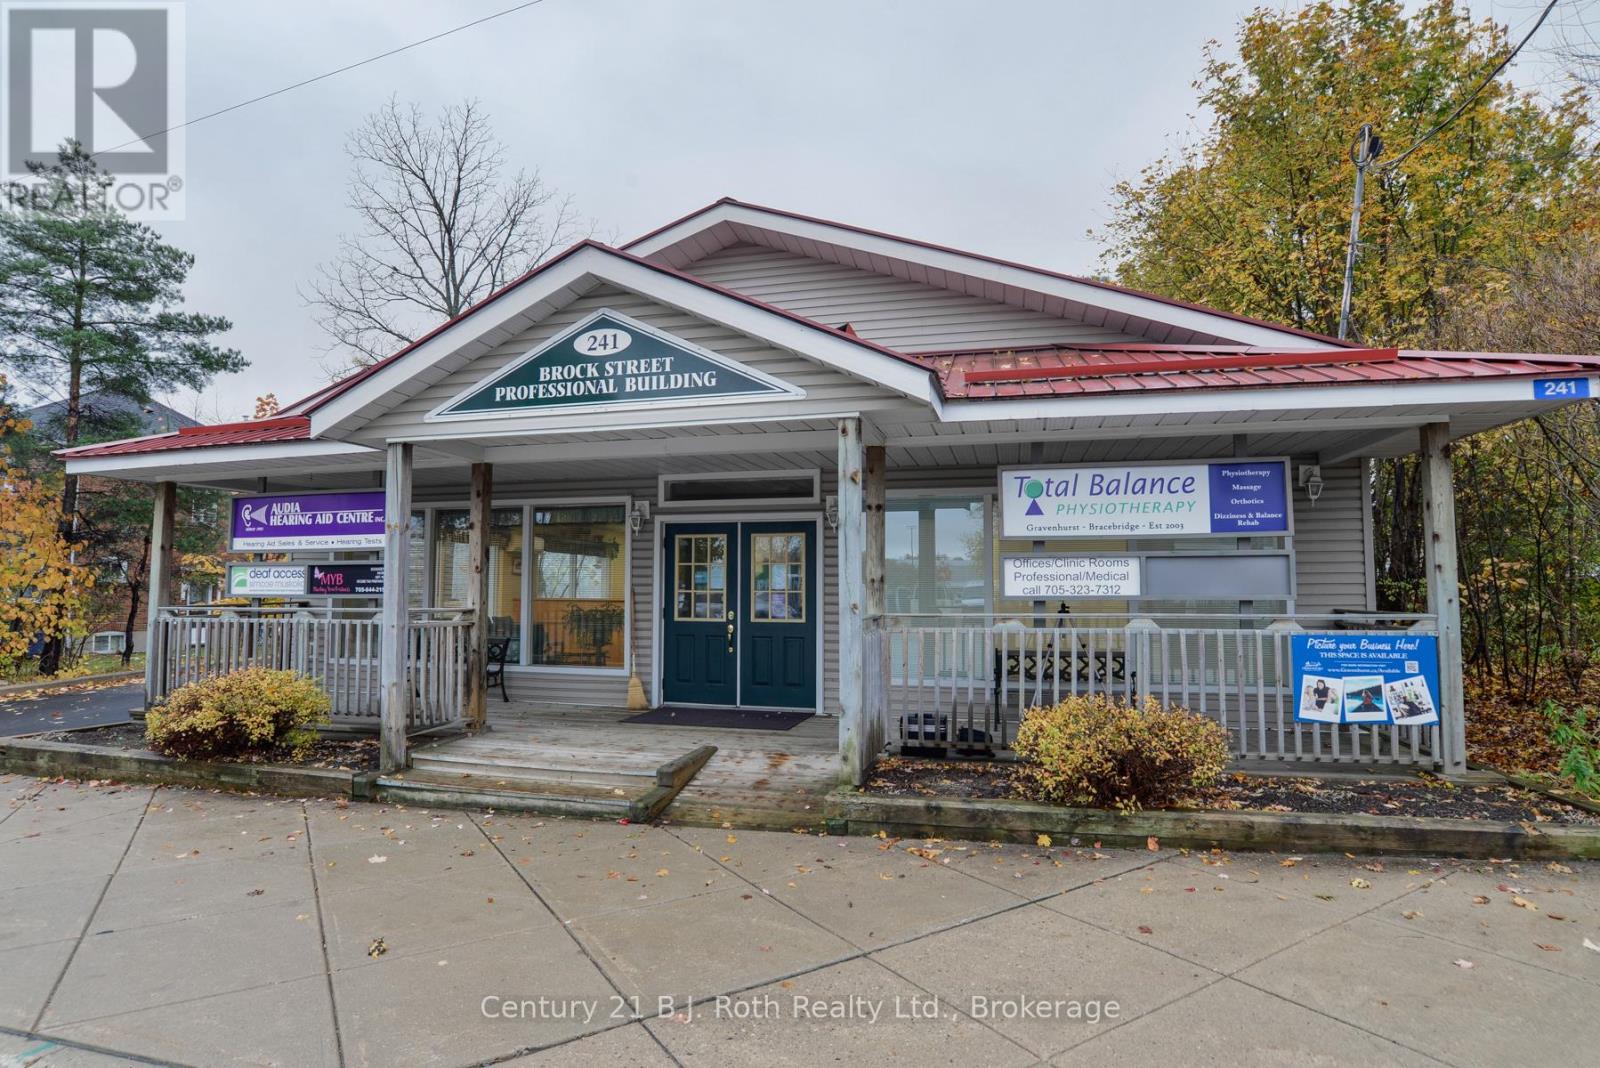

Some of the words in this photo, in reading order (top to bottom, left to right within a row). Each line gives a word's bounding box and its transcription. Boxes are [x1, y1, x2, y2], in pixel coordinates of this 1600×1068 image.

[586, 333, 619, 351] 241
[539, 362, 599, 382] BROCK
[604, 357, 673, 376] STREET
[495, 378, 618, 401] PROFESSIONAL
[625, 371, 717, 391] BUILDING
[1544, 381, 1576, 396] 241
[1221, 469, 1271, 478] Physiotherapy
[1014, 473, 1079, 498] Total
[1090, 472, 1196, 496] Balance
[271, 502, 301, 514] AUDIA
[1056, 500, 1197, 515] PHYSIOTHERAPY
[270, 512, 312, 526] HEARING
[315, 513, 334, 525] AID
[337, 511, 374, 524] CENTRE
[1255, 511, 1283, 519] Balance
[1026, 524, 1080, 533] Gravenhurst
[1089, 522, 1140, 532] Bracebridge
[1149, 521, 1163, 530] Est
[1165, 522, 1185, 531] 2003
[243, 540, 265, 548] Hearing
[305, 538, 329, 546] Service
[337, 537, 362, 546] Hearing
[364, 537, 383, 545] Tests
[1013, 558, 1087, 568] Offices/Clinic
[1089, 558, 1130, 568] Rooms
[249, 568, 271, 579] deaf
[273, 569, 305, 579] access
[321, 573, 344, 585] MYB
[1014, 571, 1130, 582] Professional/Medical
[1022, 585, 1041, 595] call
[1044, 585, 1121, 595] 705-323-7312
[1307, 638, 1337, 650] Picture
[1339, 642, 1357, 652] your
[1360, 638, 1392, 650] Business
[1395, 638, 1420, 650] Here!
[1369, 652, 1409, 660] AVAILABLE
